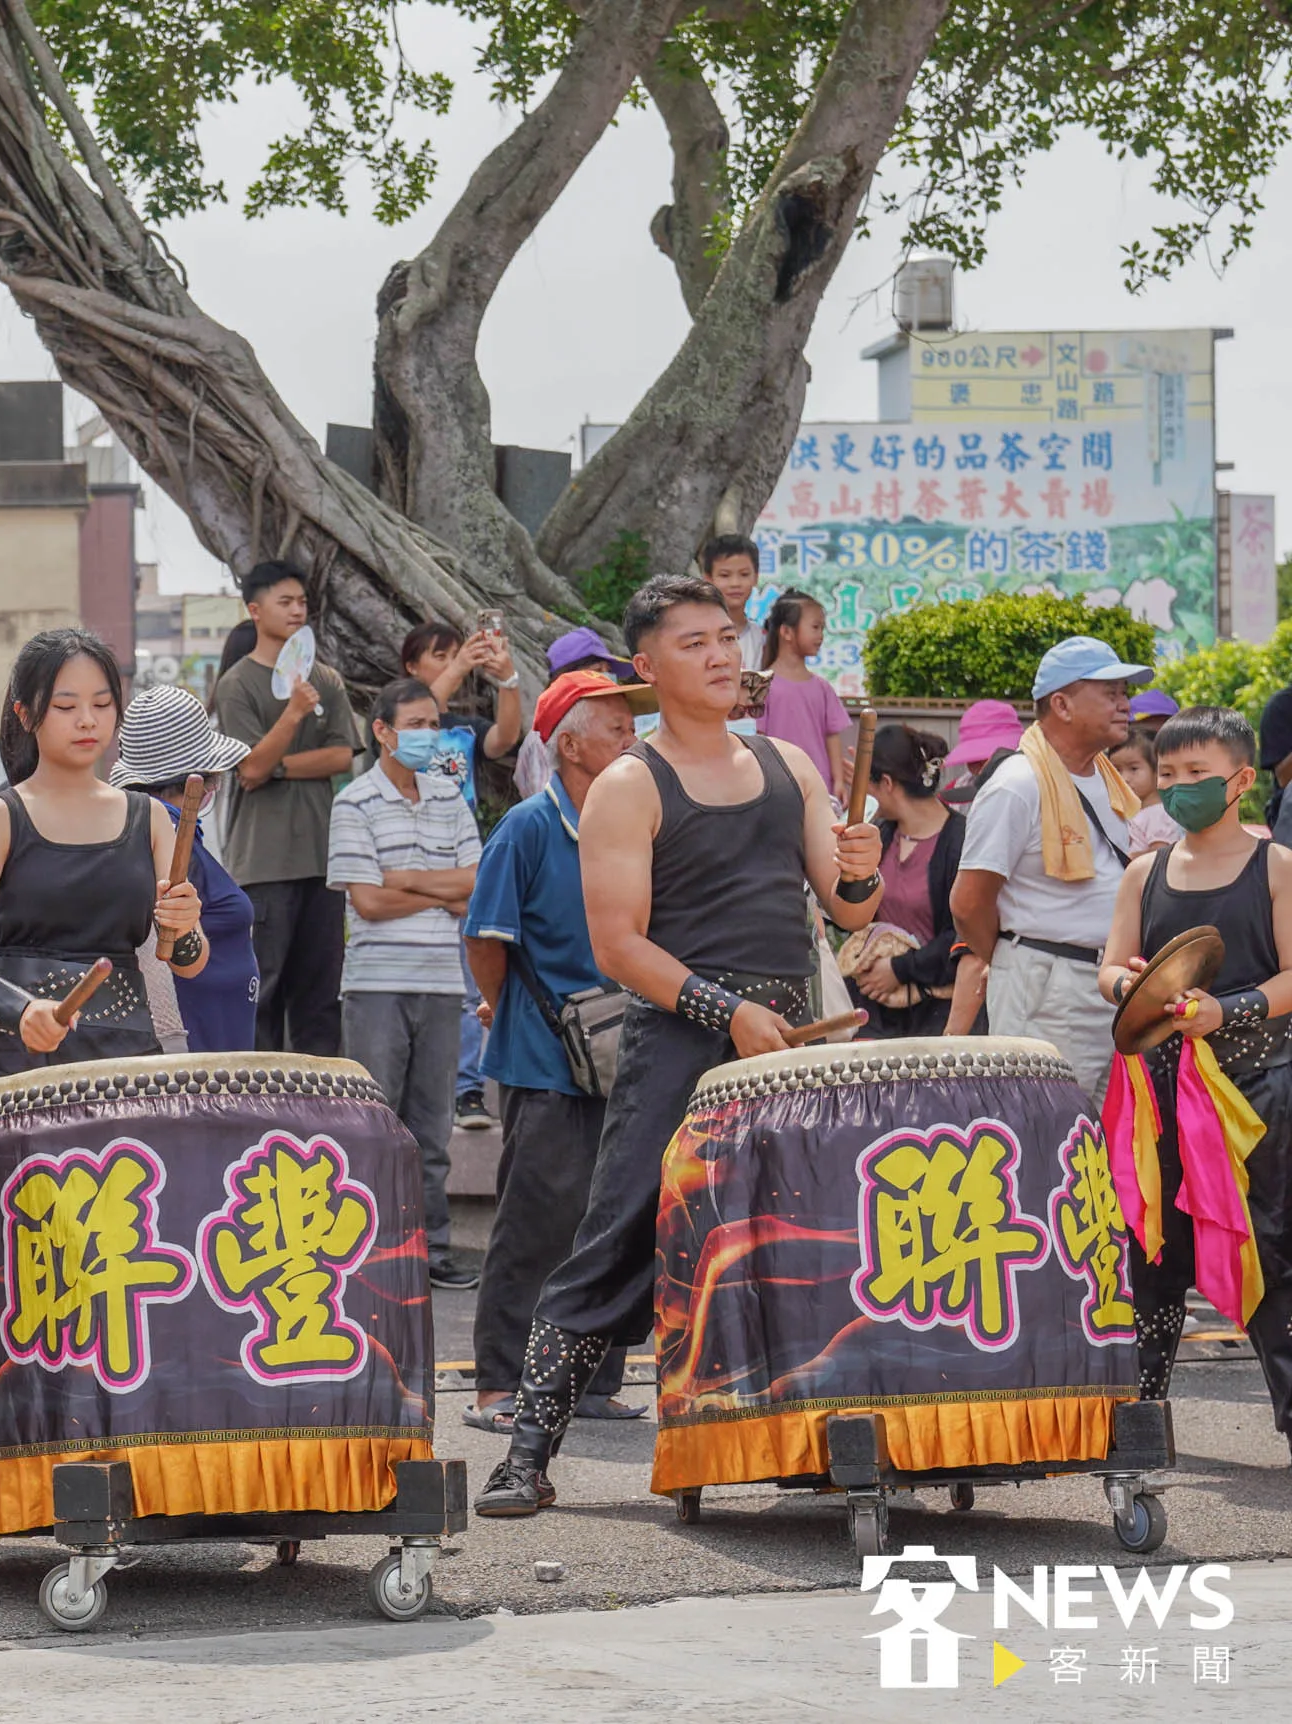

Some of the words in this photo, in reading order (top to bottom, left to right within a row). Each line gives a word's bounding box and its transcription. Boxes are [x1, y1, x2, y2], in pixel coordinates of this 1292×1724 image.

[921, 345, 1018, 368] 900公尺
[1056, 343, 1079, 420] 文山路
